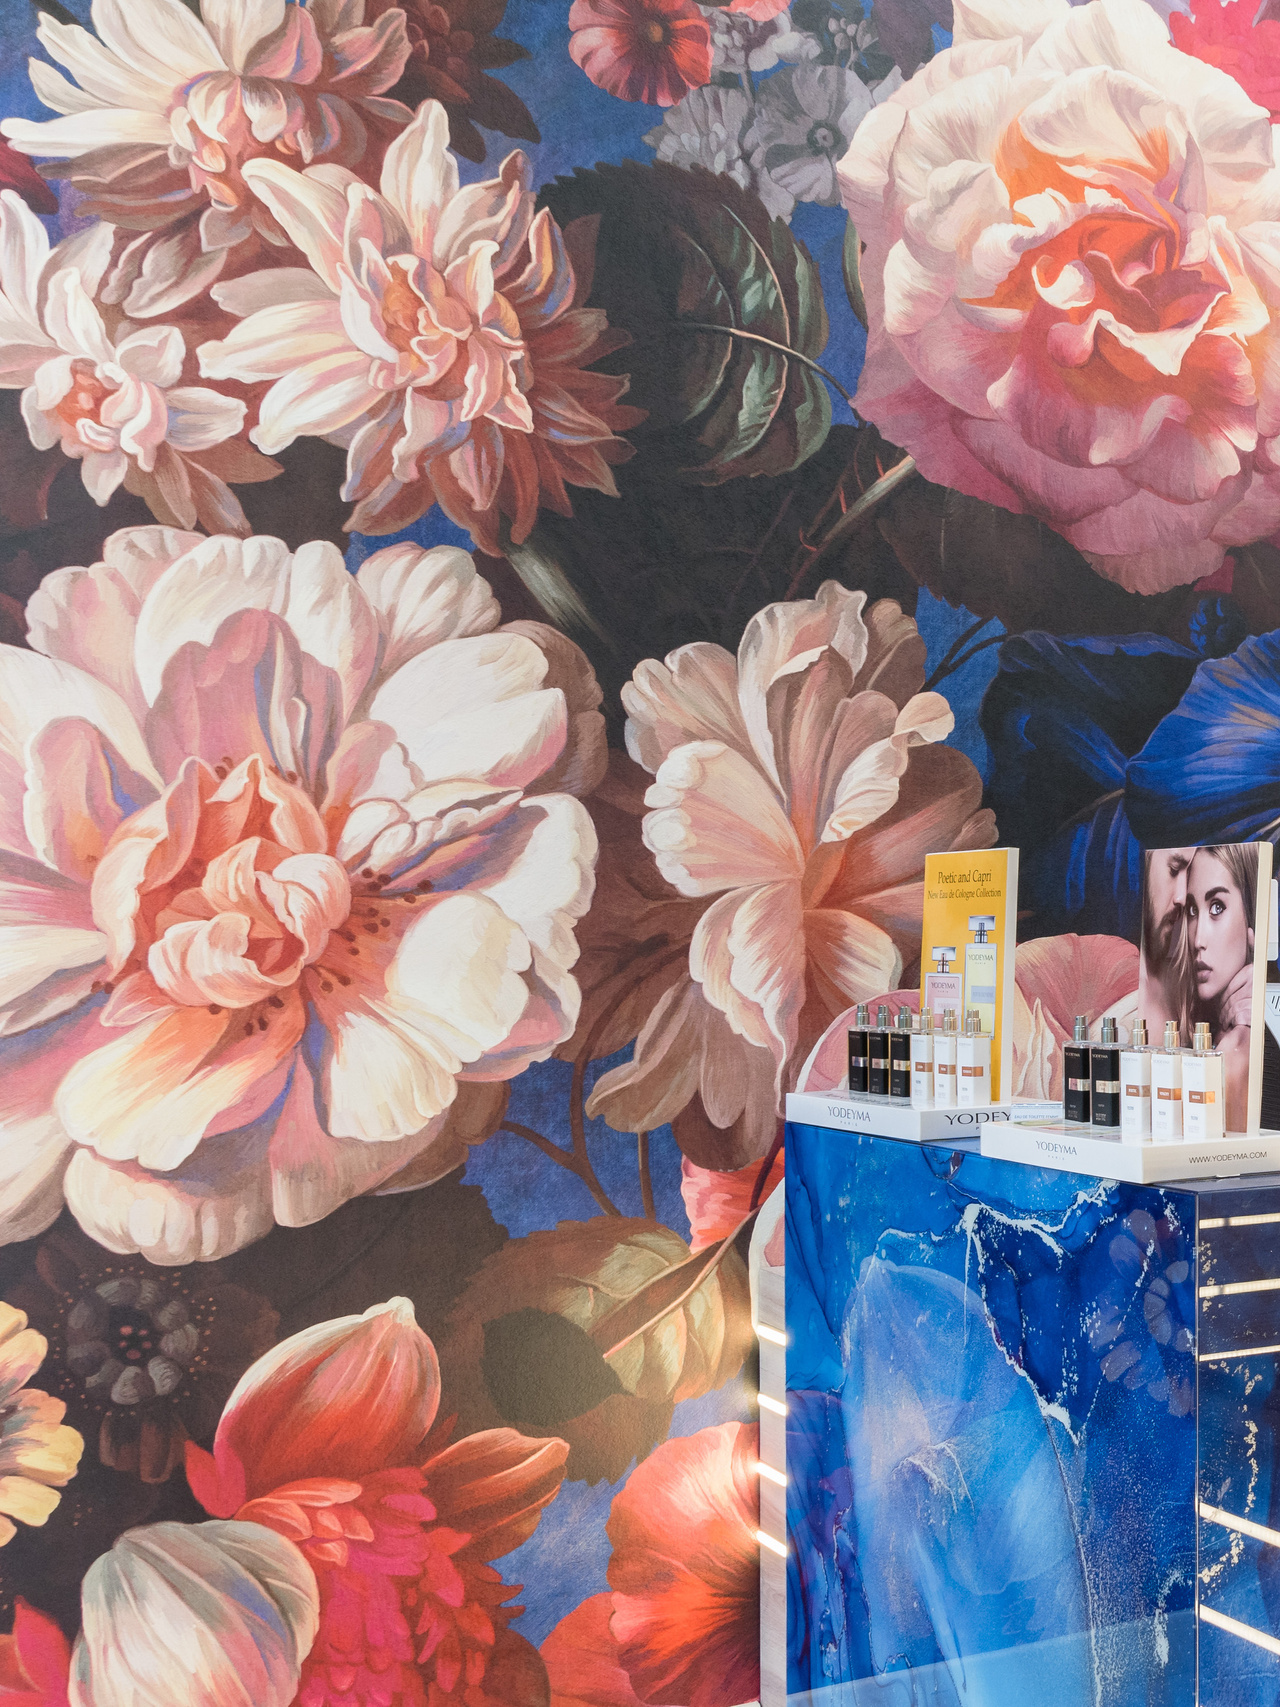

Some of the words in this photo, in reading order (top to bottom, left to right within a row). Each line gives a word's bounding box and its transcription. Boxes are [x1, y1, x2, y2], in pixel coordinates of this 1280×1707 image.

[937, 871, 956, 884] Poetic
[958, 870, 971, 883] and
[972, 869, 992, 886] Capri
[928, 890, 939, 899] New
[939, 890, 948, 899] Eau
[949, 889, 955, 899] de
[955, 888, 975, 901] Cologne
[976, 888, 1002, 898] Collection
[968, 954, 994, 962] YODEYMA
[931, 981, 956, 990] YODEYMA
[827, 1105, 871, 1123] YODEYMA
[944, 1111, 1011, 1126] YODEY
[1035, 1140, 1077, 1155] YODEYMA
[1188, 1151, 1268, 1164] WWW.YODEYMA.COM
